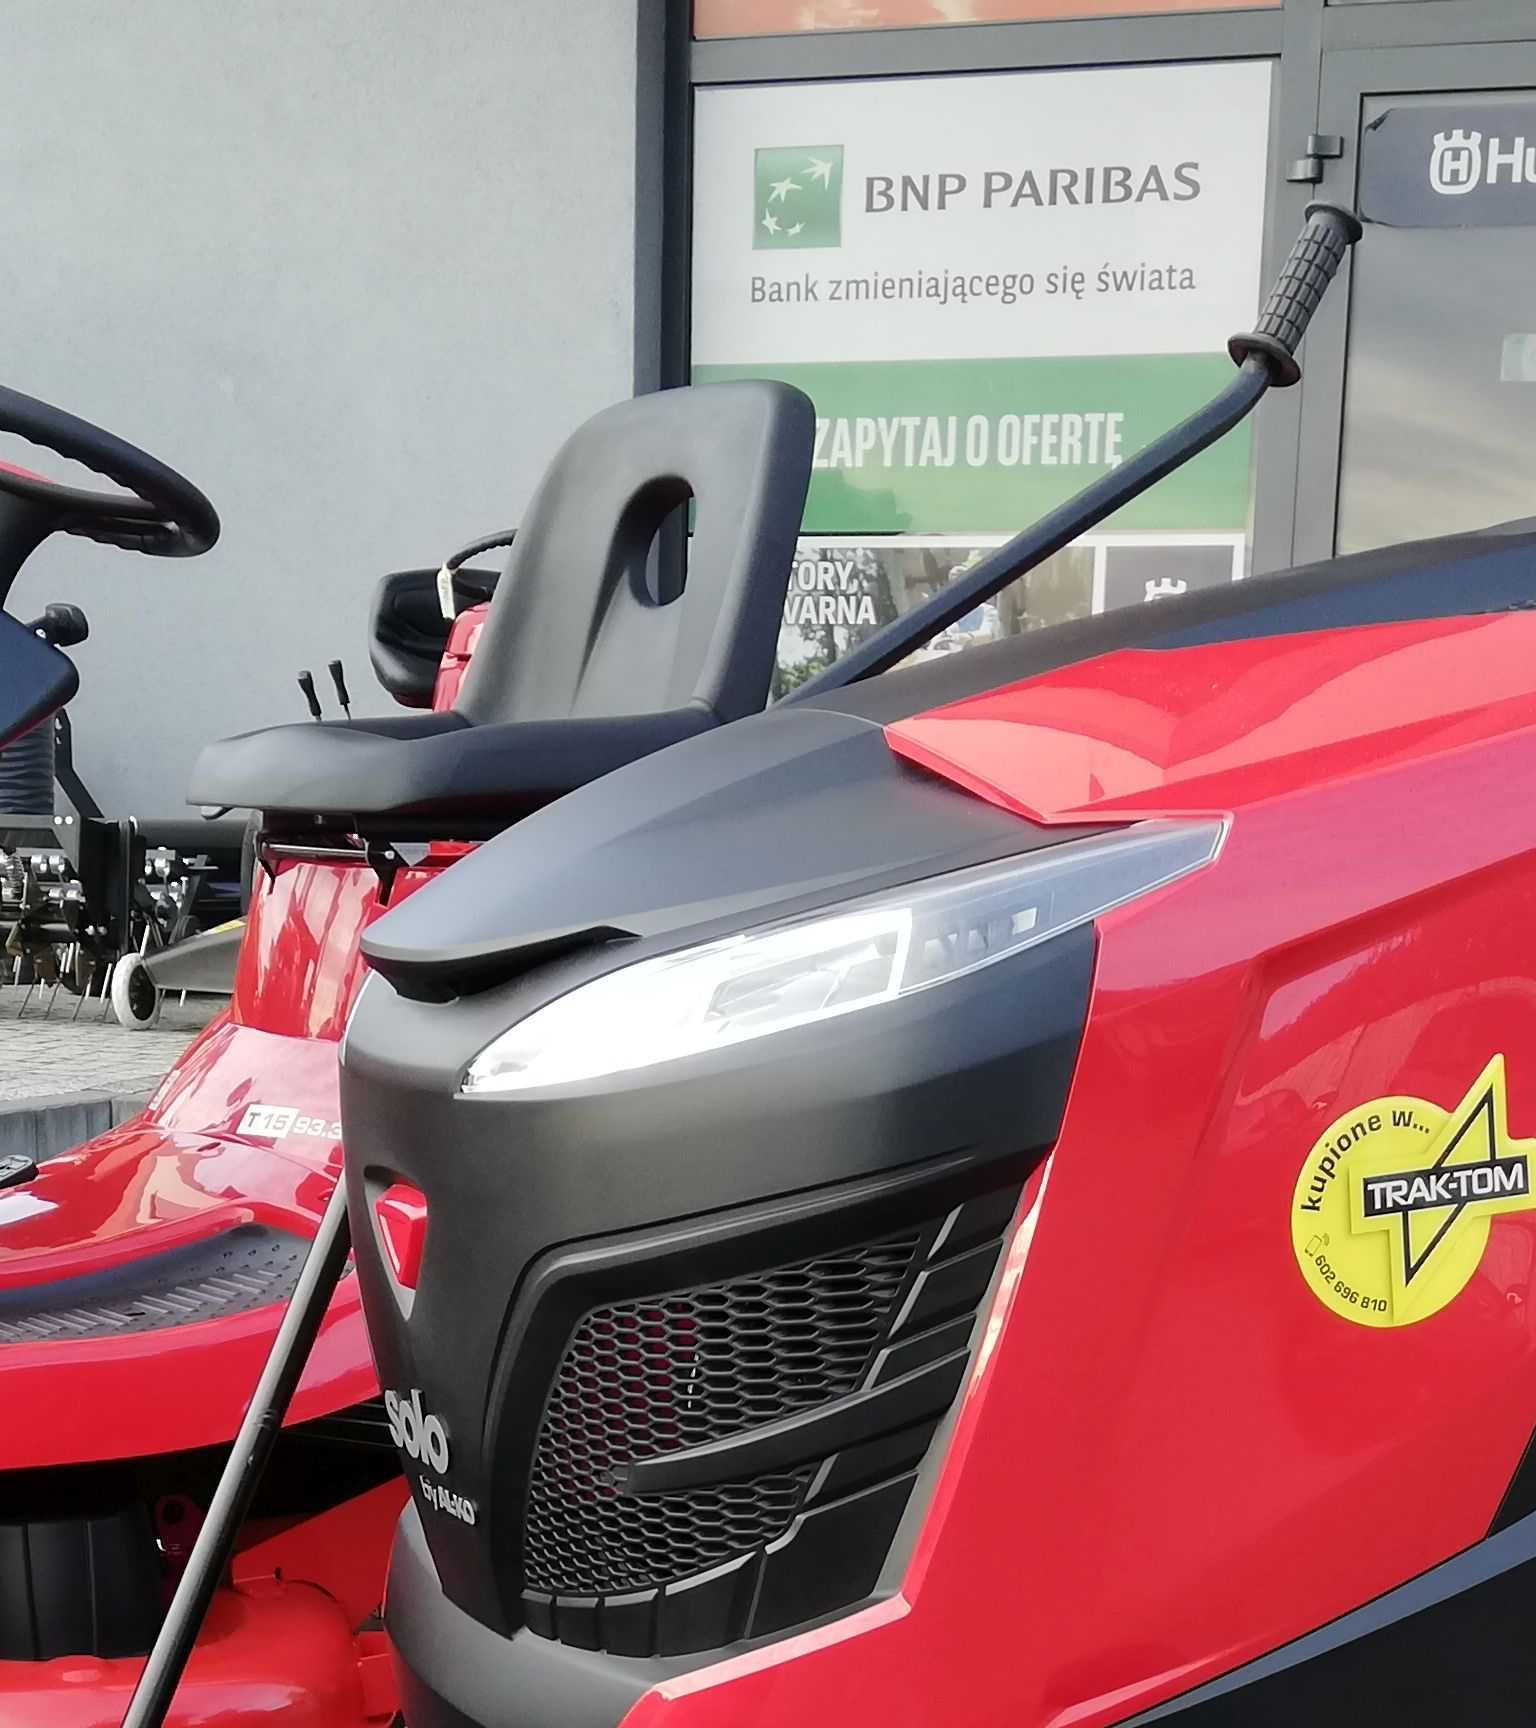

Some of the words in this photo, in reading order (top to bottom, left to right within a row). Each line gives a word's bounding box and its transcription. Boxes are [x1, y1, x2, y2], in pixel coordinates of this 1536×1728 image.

[865, 174, 967, 213] BNP
[983, 161, 1201, 207] PARIBAS
[750, 273, 819, 303] Bank
[828, 270, 1035, 305] zmieniającego
[1045, 265, 1085, 300] się
[1095, 262, 1196, 292] świata
[813, 415, 956, 468] ZAPYTAJ
[966, 415, 990, 466] O
[997, 412, 1125, 470] OFERTĘ
[248, 1112, 261, 1128] T
[263, 1113, 289, 1130] 15
[1300, 1114, 1382, 1212] kupione
[1367, 1163, 1525, 1210] TRAK-TOM
[1314, 1254, 1337, 1285] 602
[1333, 1280, 1358, 1305] 696
[1360, 1296, 1388, 1313] 810
[384, 1388, 449, 1475] solo
